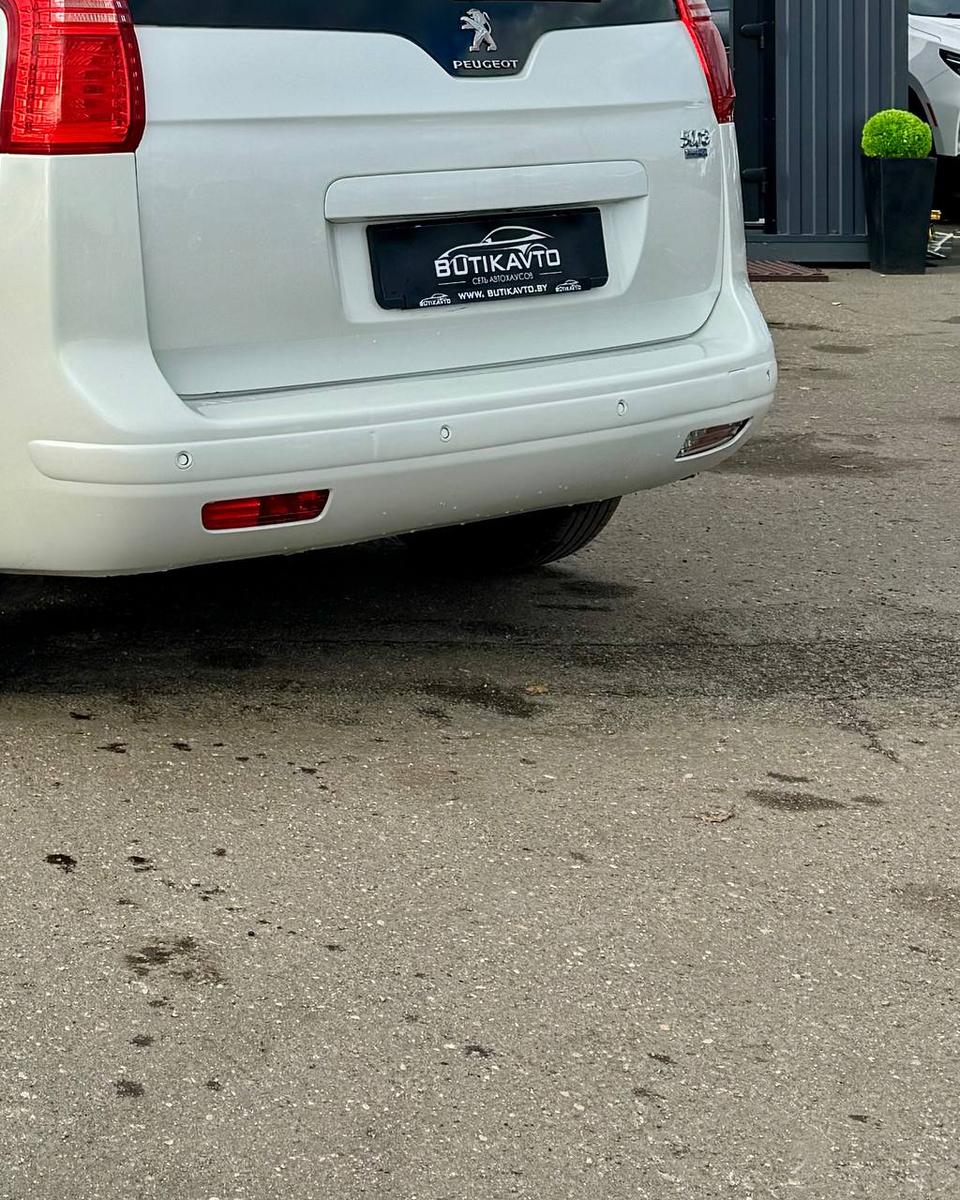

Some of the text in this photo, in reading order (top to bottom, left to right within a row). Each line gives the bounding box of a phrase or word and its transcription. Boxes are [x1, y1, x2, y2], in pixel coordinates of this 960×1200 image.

[453, 60, 518, 69] PEUGEOT
[434, 249, 561, 278] BUTIKAVTO
[472, 277, 488, 285] СЕТЬ
[458, 284, 548, 300] WWW. BUTIKAVTO.BY
